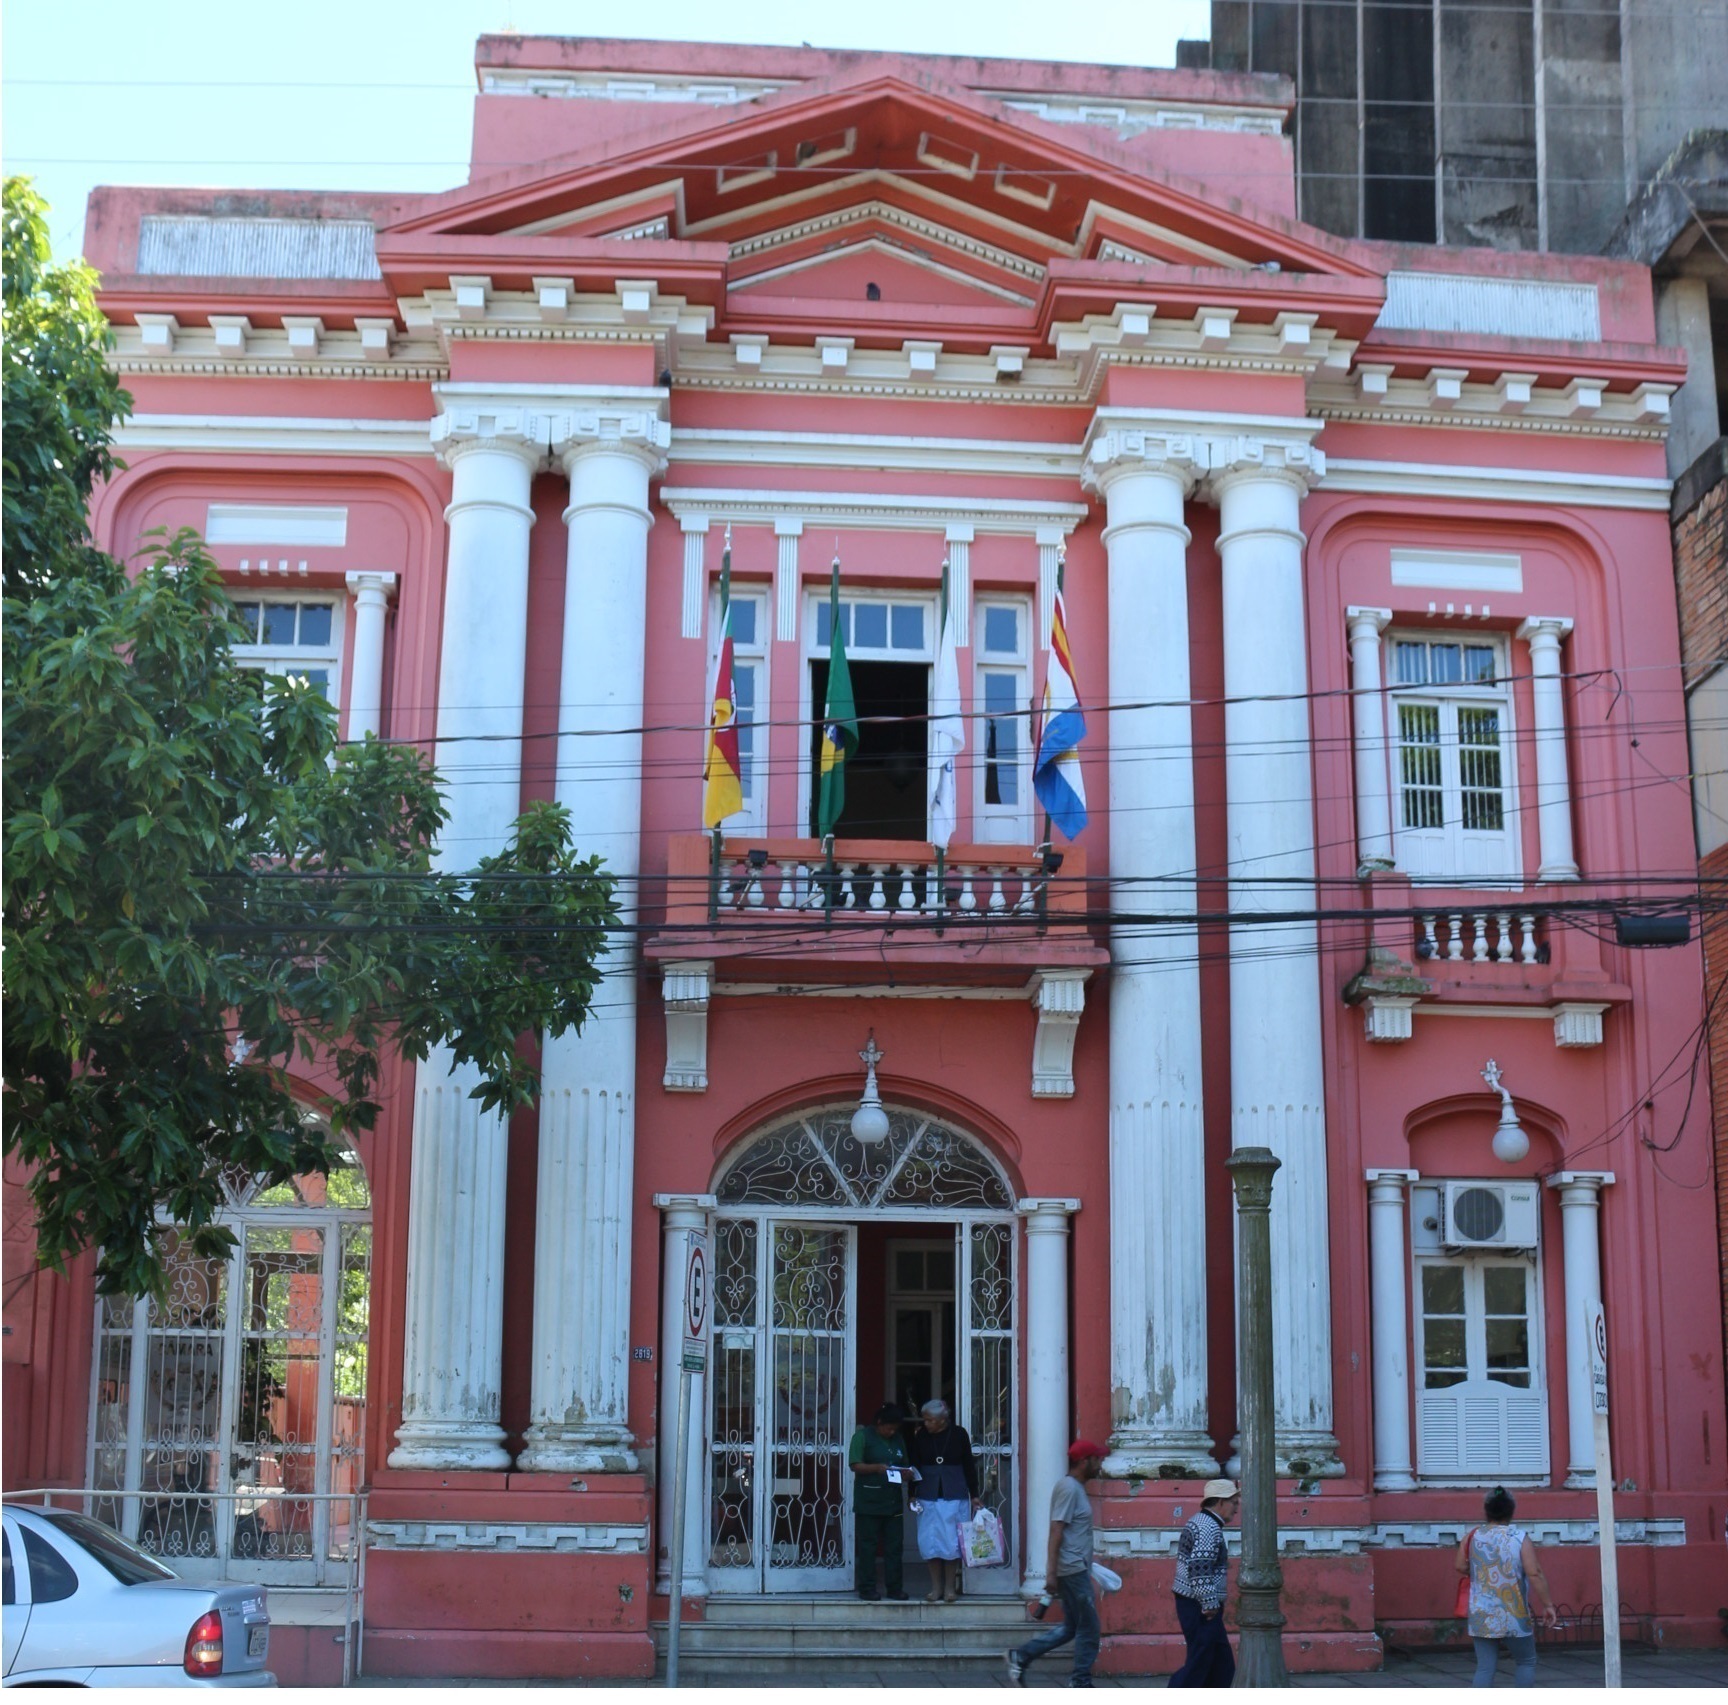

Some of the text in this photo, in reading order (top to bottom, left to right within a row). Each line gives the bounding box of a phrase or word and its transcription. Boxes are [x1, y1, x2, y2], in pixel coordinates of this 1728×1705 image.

[1510, 1194, 1530, 1202] Consul
[693, 1267, 701, 1318] E
[634, 1348, 651, 1359] 2619
[779, 1426, 837, 1440] MUNICPAL
